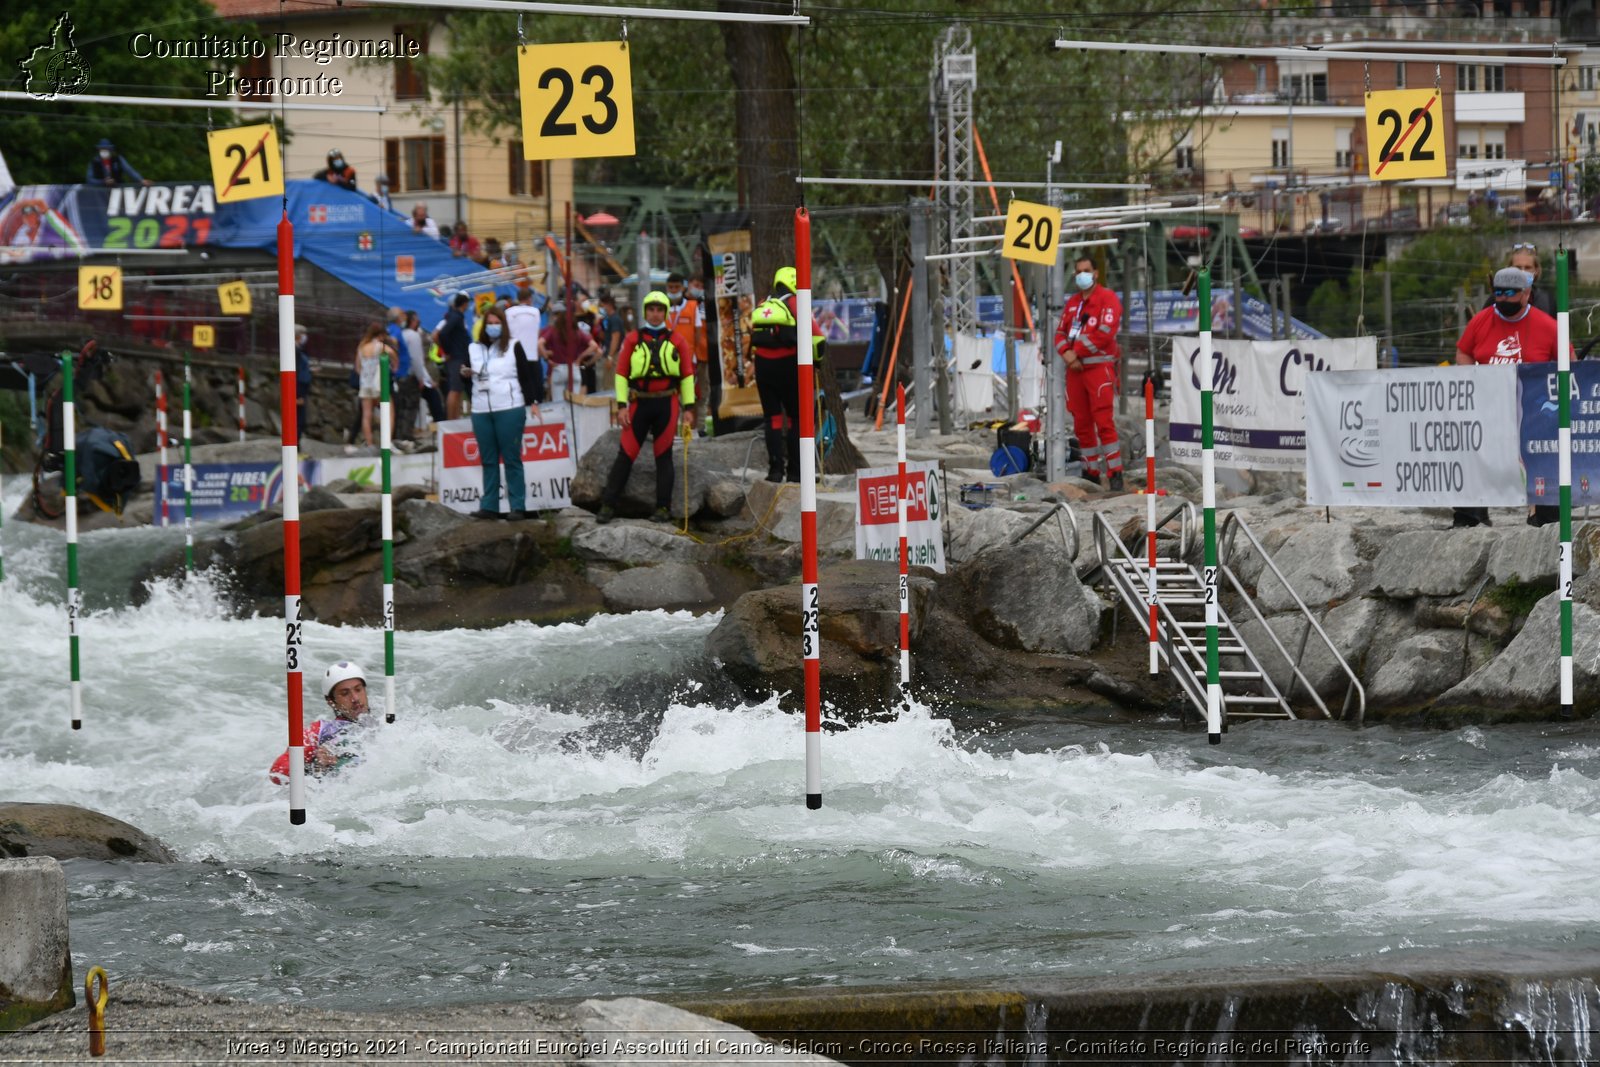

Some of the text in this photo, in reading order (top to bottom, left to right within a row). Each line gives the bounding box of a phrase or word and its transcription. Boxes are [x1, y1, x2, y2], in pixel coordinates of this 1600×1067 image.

[537, 65, 619, 137] 23
[1377, 107, 1435, 163] 22
[224, 139, 271, 187] 21
[106, 184, 216, 216] IVREA
[102, 215, 212, 249] 2021
[1012, 213, 1054, 253] 20
[88, 275, 114, 301] 18
[722, 252, 738, 297] KIND
[225, 287, 244, 306] 15
[1385, 380, 1475, 413] ISTITUTO PER
[1339, 400, 1364, 431] ICS
[1409, 419, 1483, 452] IL CREDITO
[230, 471, 267, 486] IVREA
[230, 485, 265, 502] 2021
[443, 486, 481, 504] PIAZZA
[530, 482, 543, 498] 21
[1395, 461, 1464, 493] SPORTIVO
[867, 481, 927, 516] DESAR
